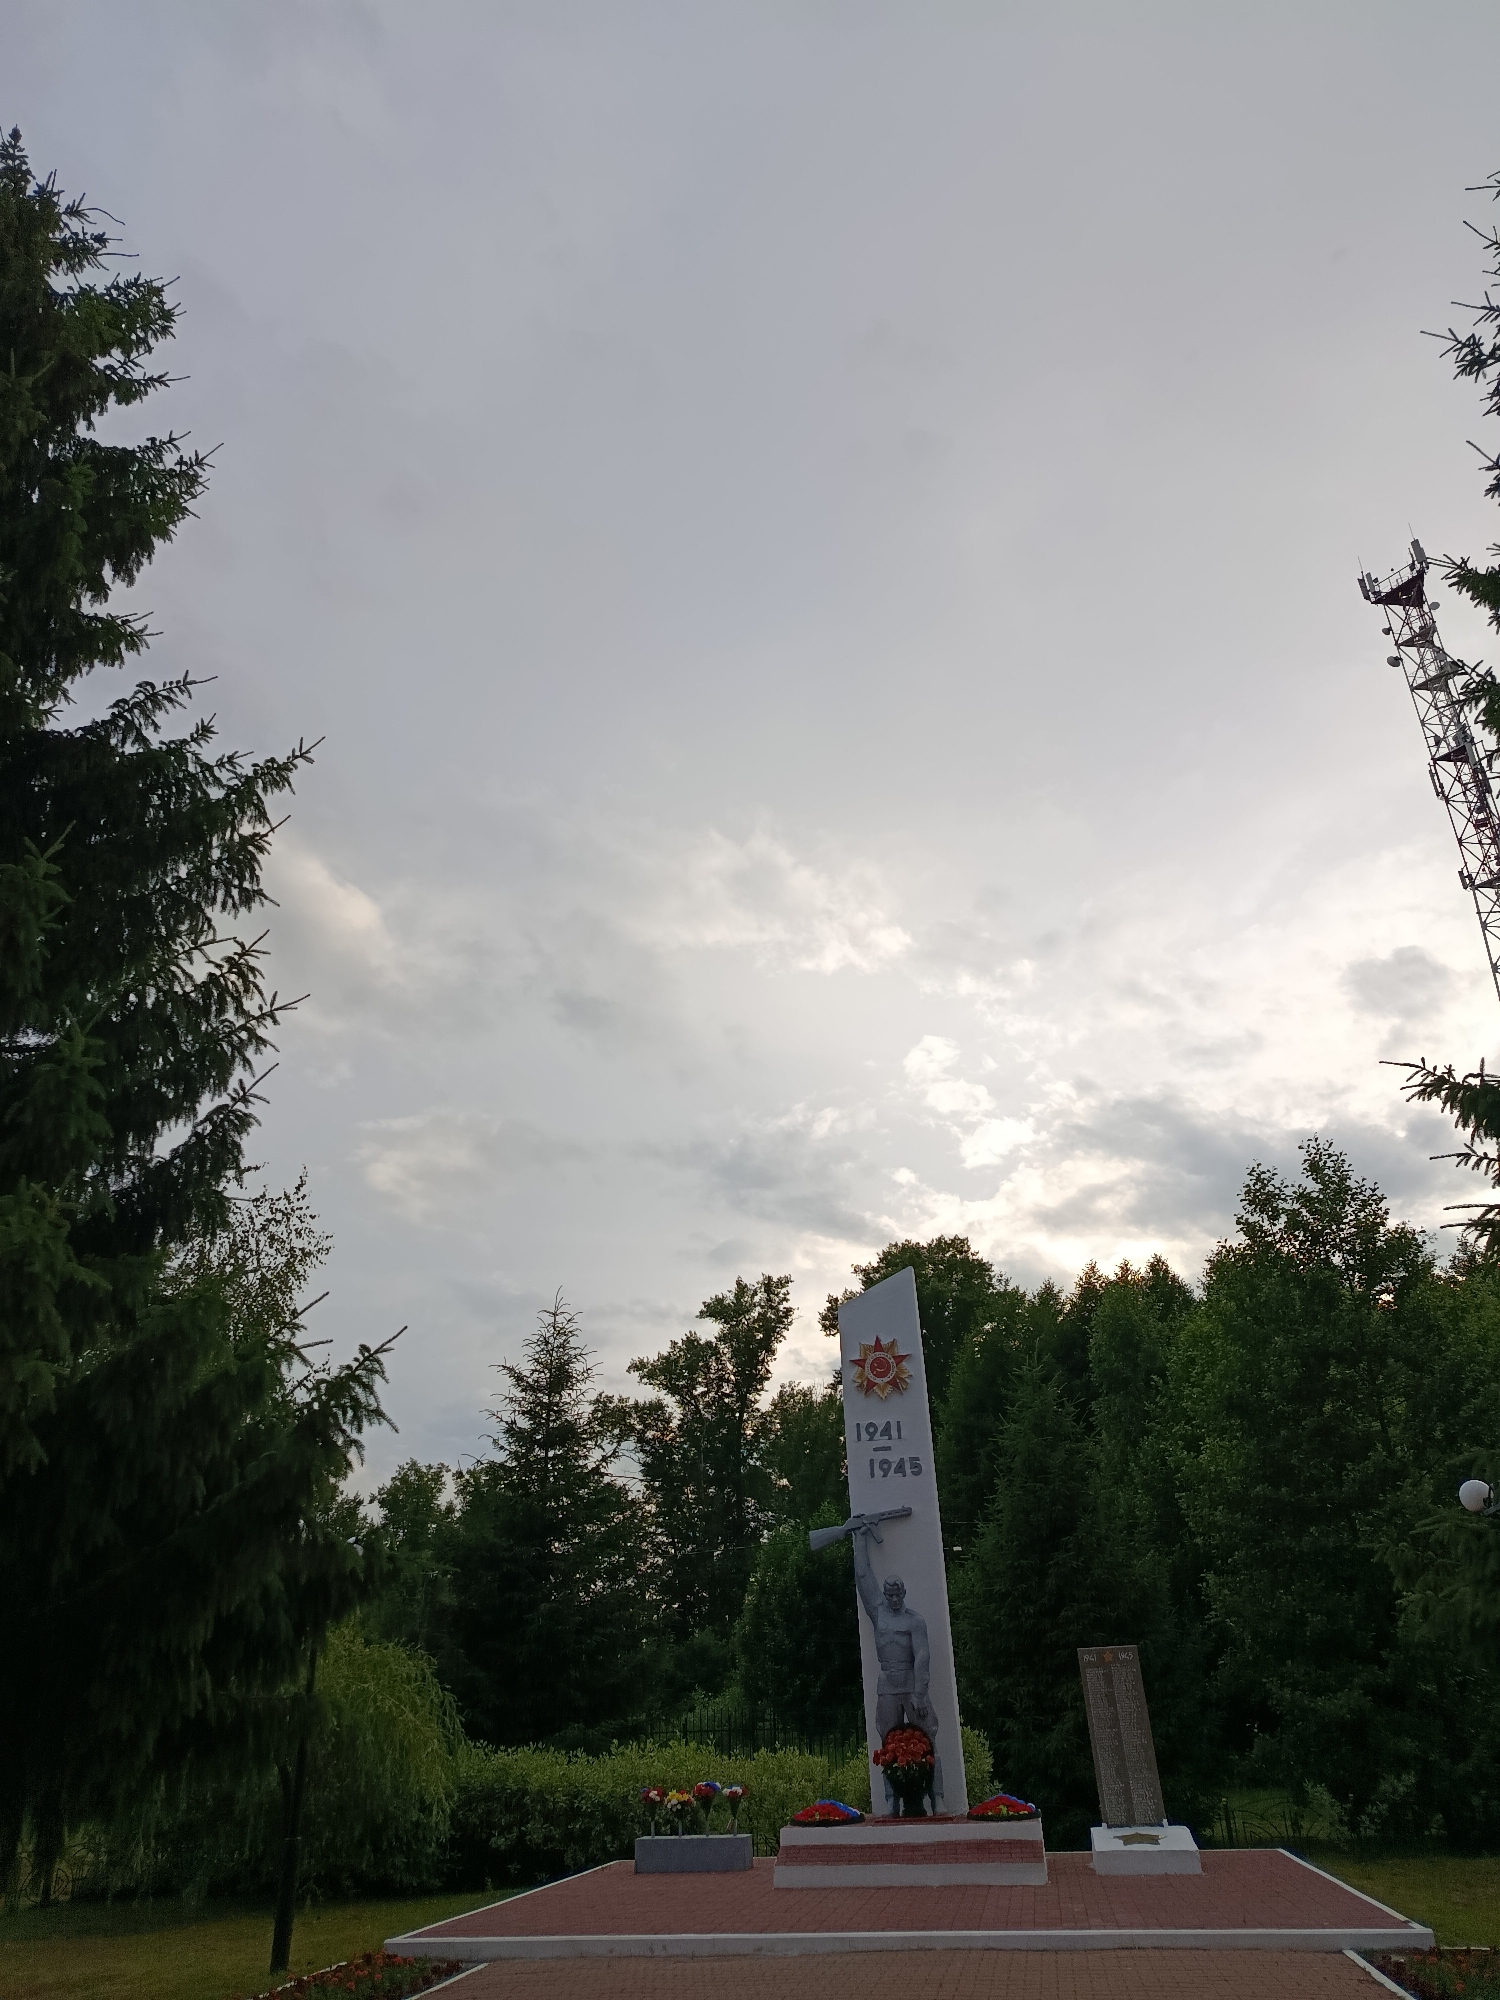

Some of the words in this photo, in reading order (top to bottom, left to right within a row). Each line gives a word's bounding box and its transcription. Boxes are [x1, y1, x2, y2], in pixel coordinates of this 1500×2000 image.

[856, 1421, 902, 1441] 1941
[869, 1457, 923, 1478] 1945
[1083, 1654, 1097, 1662] 1941
[1118, 1652, 1134, 1660] 1945
